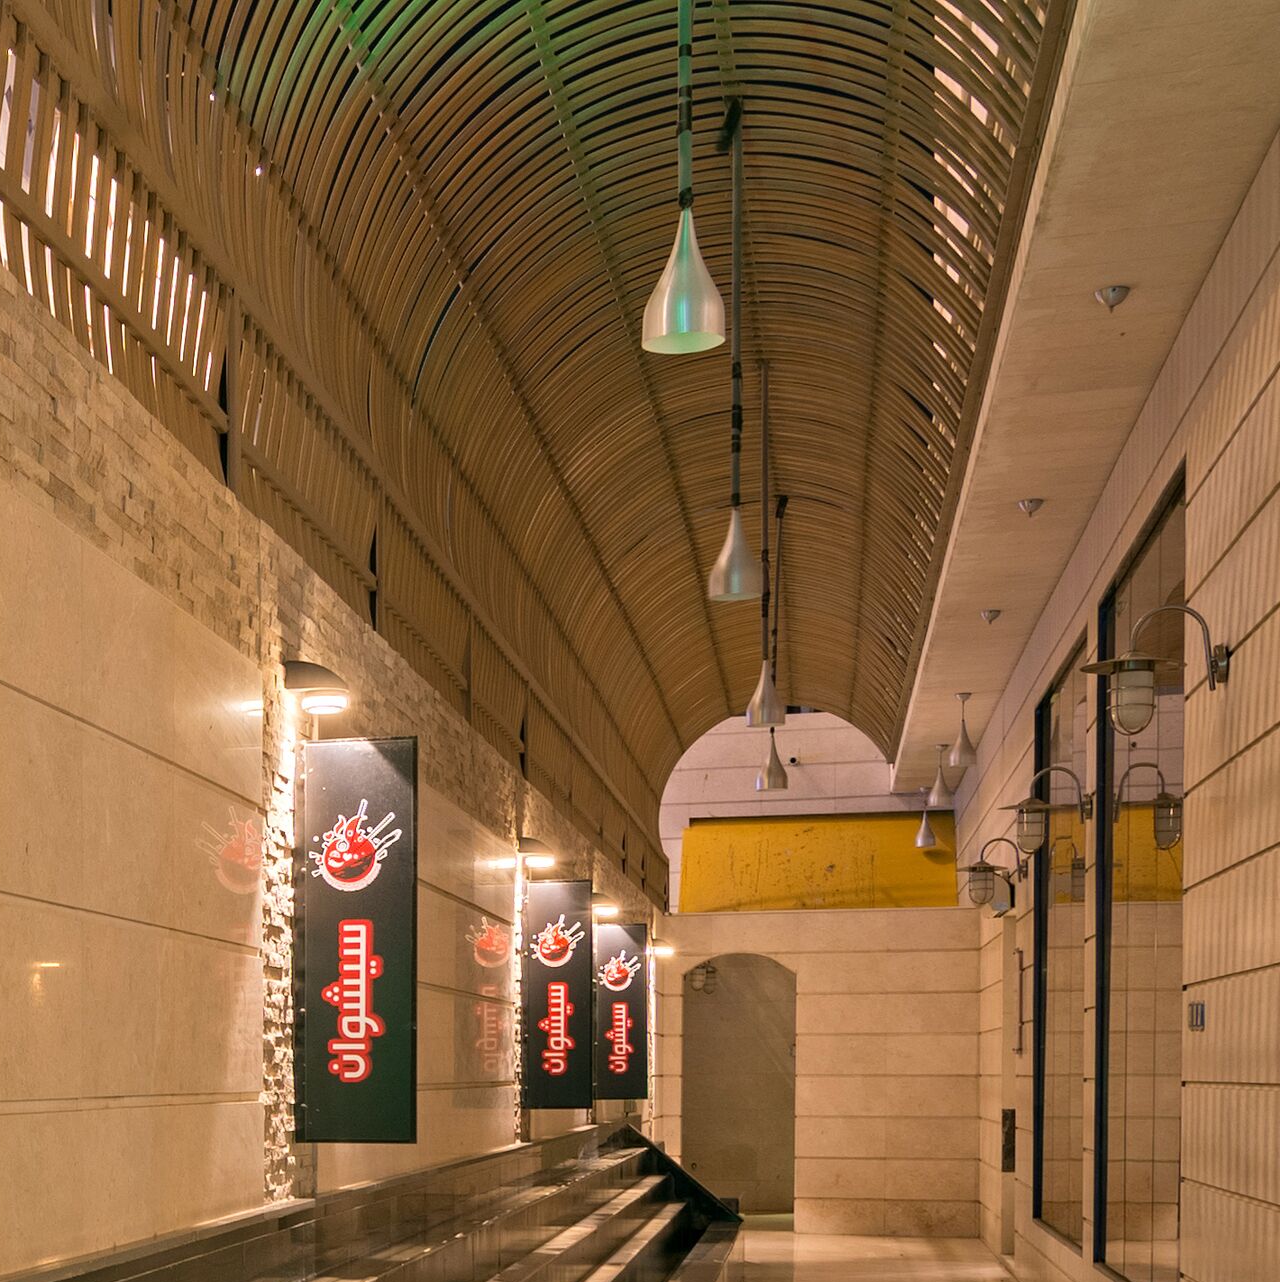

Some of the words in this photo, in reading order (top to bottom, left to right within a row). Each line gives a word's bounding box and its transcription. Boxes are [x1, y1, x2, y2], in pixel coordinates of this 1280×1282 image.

[324, 923, 381, 1080] سيشوان
[539, 983, 573, 1074] سيشوان
[606, 1003, 633, 1073] سيشوان
